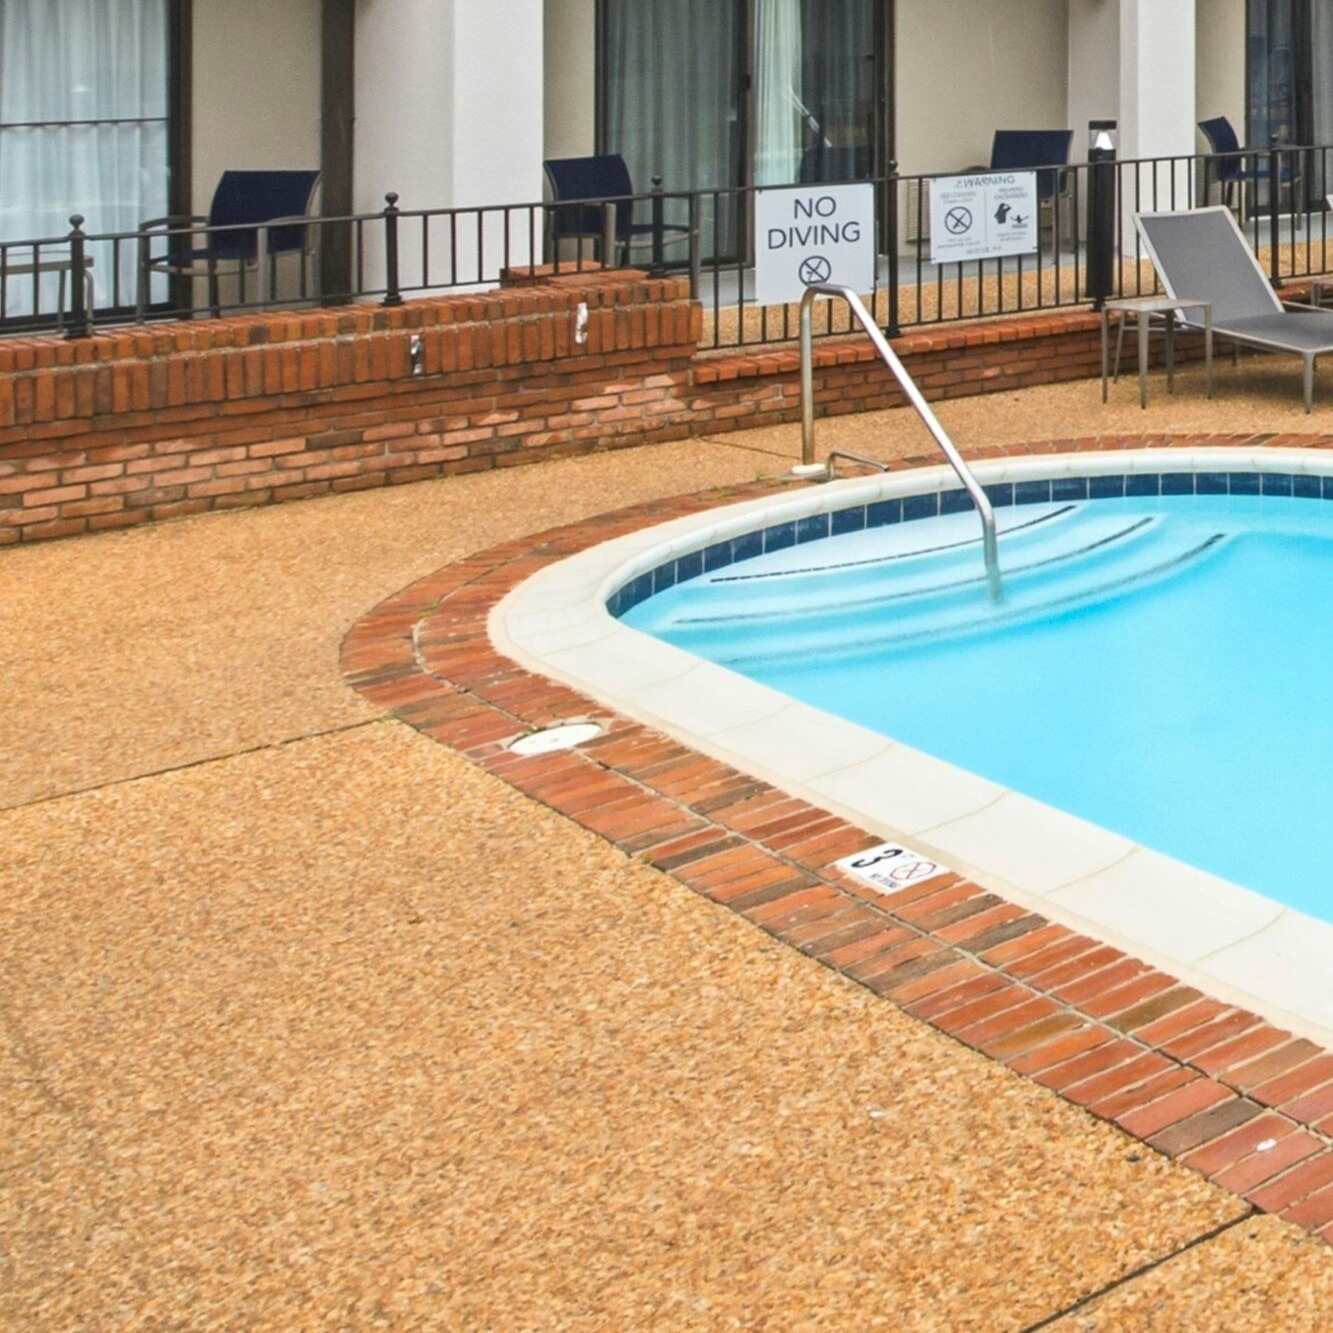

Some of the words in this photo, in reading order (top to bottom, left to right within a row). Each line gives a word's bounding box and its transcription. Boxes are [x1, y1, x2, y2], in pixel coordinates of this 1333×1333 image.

[794, 195, 836, 219] NO
[768, 221, 860, 249] DIVING
[851, 848, 903, 868] 3
